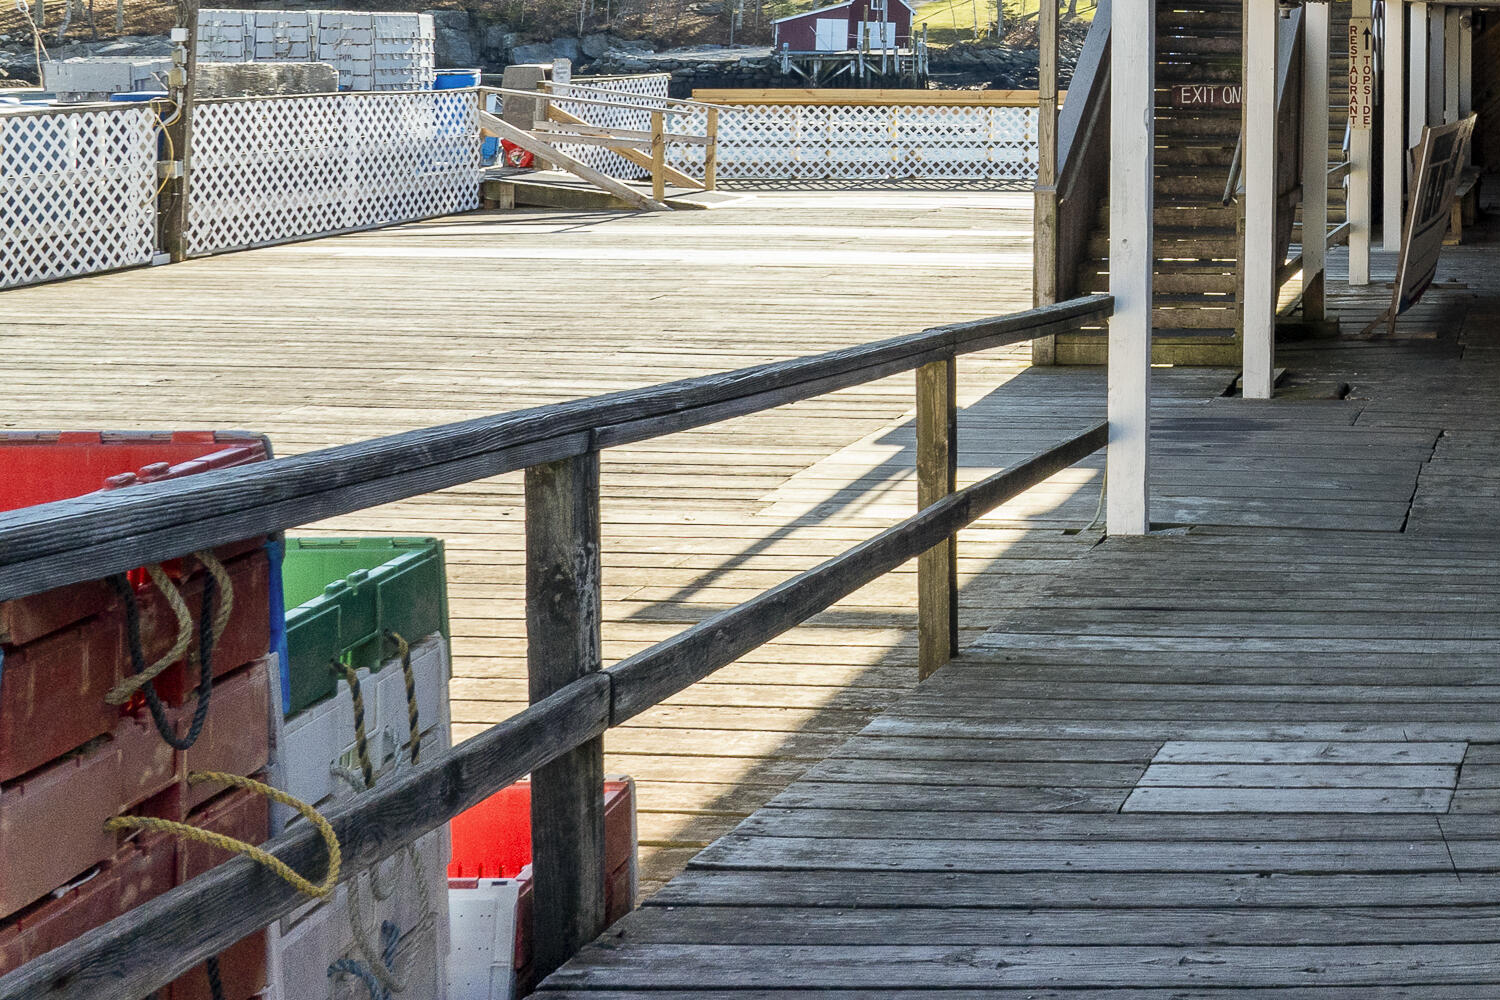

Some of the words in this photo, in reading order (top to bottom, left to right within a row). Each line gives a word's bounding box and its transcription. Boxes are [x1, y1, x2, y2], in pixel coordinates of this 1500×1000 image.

[1181, 86, 1219, 104] EXIT
[1350, 25, 1359, 125] RESTAURANT
[1362, 55, 1371, 125] TOPSIDE
